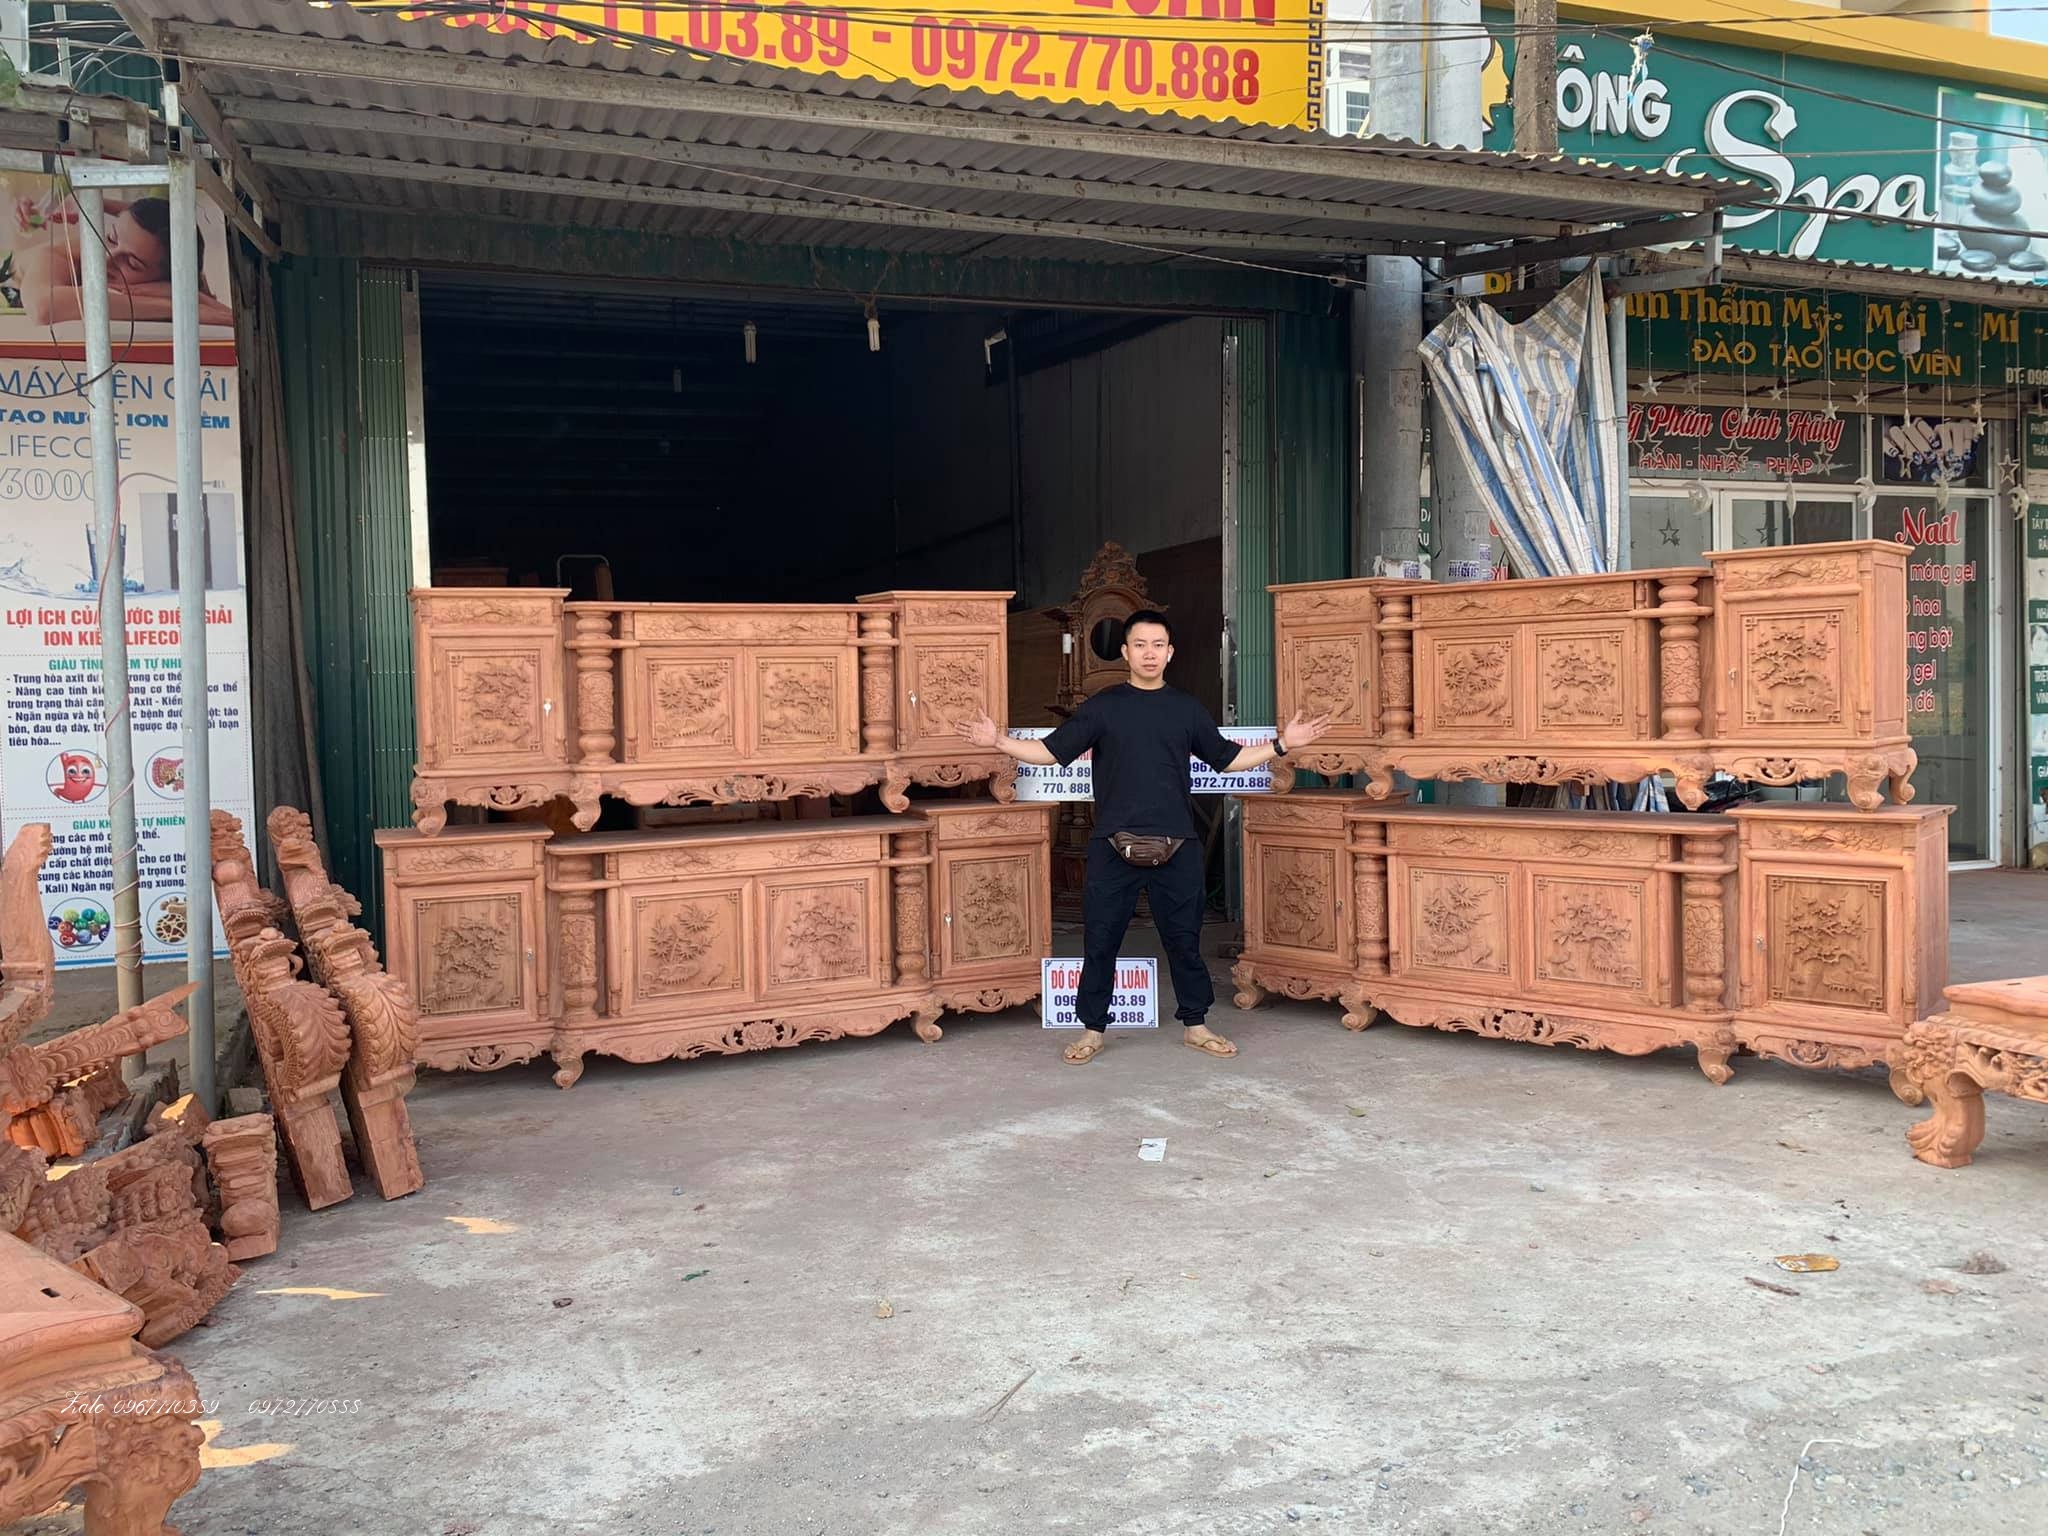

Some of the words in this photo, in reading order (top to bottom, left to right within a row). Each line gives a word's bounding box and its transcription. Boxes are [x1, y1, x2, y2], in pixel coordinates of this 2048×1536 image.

[911, 15, 1260, 106] 0972.770.888
[1556, 44, 1672, 141] ÔNG
[1662, 89, 1938, 258] Spa
[1673, 283, 1772, 326] Thẩm
[1691, 331, 1757, 365] ĐÀO
[1769, 343, 1823, 374] TẠO
[1835, 347, 1896, 378] HỌC
[1909, 348, 1961, 377] VIÊN
[0, 366, 64, 397] MÁY
[76, 369, 153, 405] ỆN
[126, 414, 169, 428] ION
[0, 434, 133, 461] LIFECE
[1766, 451, 1814, 474] PHÁP
[1895, 506, 1961, 546] Nail
[1910, 558, 1951, 587] móng
[1954, 561, 1977, 586] gel
[1912, 595, 1941, 617] hoa
[6, 608, 33, 629] LỢI
[37, 606, 66, 625] ÍCH
[44, 631, 73, 646] ION
[125, 630, 182, 646] LIFECO
[48, 657, 77, 671] GIÀU
[1914, 660, 1937, 686] gel
[13, 673, 42, 684] Trung
[65, 672, 84, 683] axit
[128, 672, 151, 682] rong
[16, 686, 42, 697] Nâng
[46, 686, 65, 696] cao
[128, 685, 146, 696] ong
[7, 699, 33, 710] trong
[36, 699, 62, 711] trạng
[133, 697, 153, 707] Axit
[15, 711, 42, 722] Ngăn
[72, 711, 84, 720] và
[140, 708, 164, 721] bệnh
[33, 723, 52, 734] đau
[8, 737, 28, 747] tiêu
[139, 854, 157, 864] cho
[37, 871, 61, 882] sung
[71, 881, 97, 893] Ngăn
[1121, 966, 1149, 989] LUÂN
